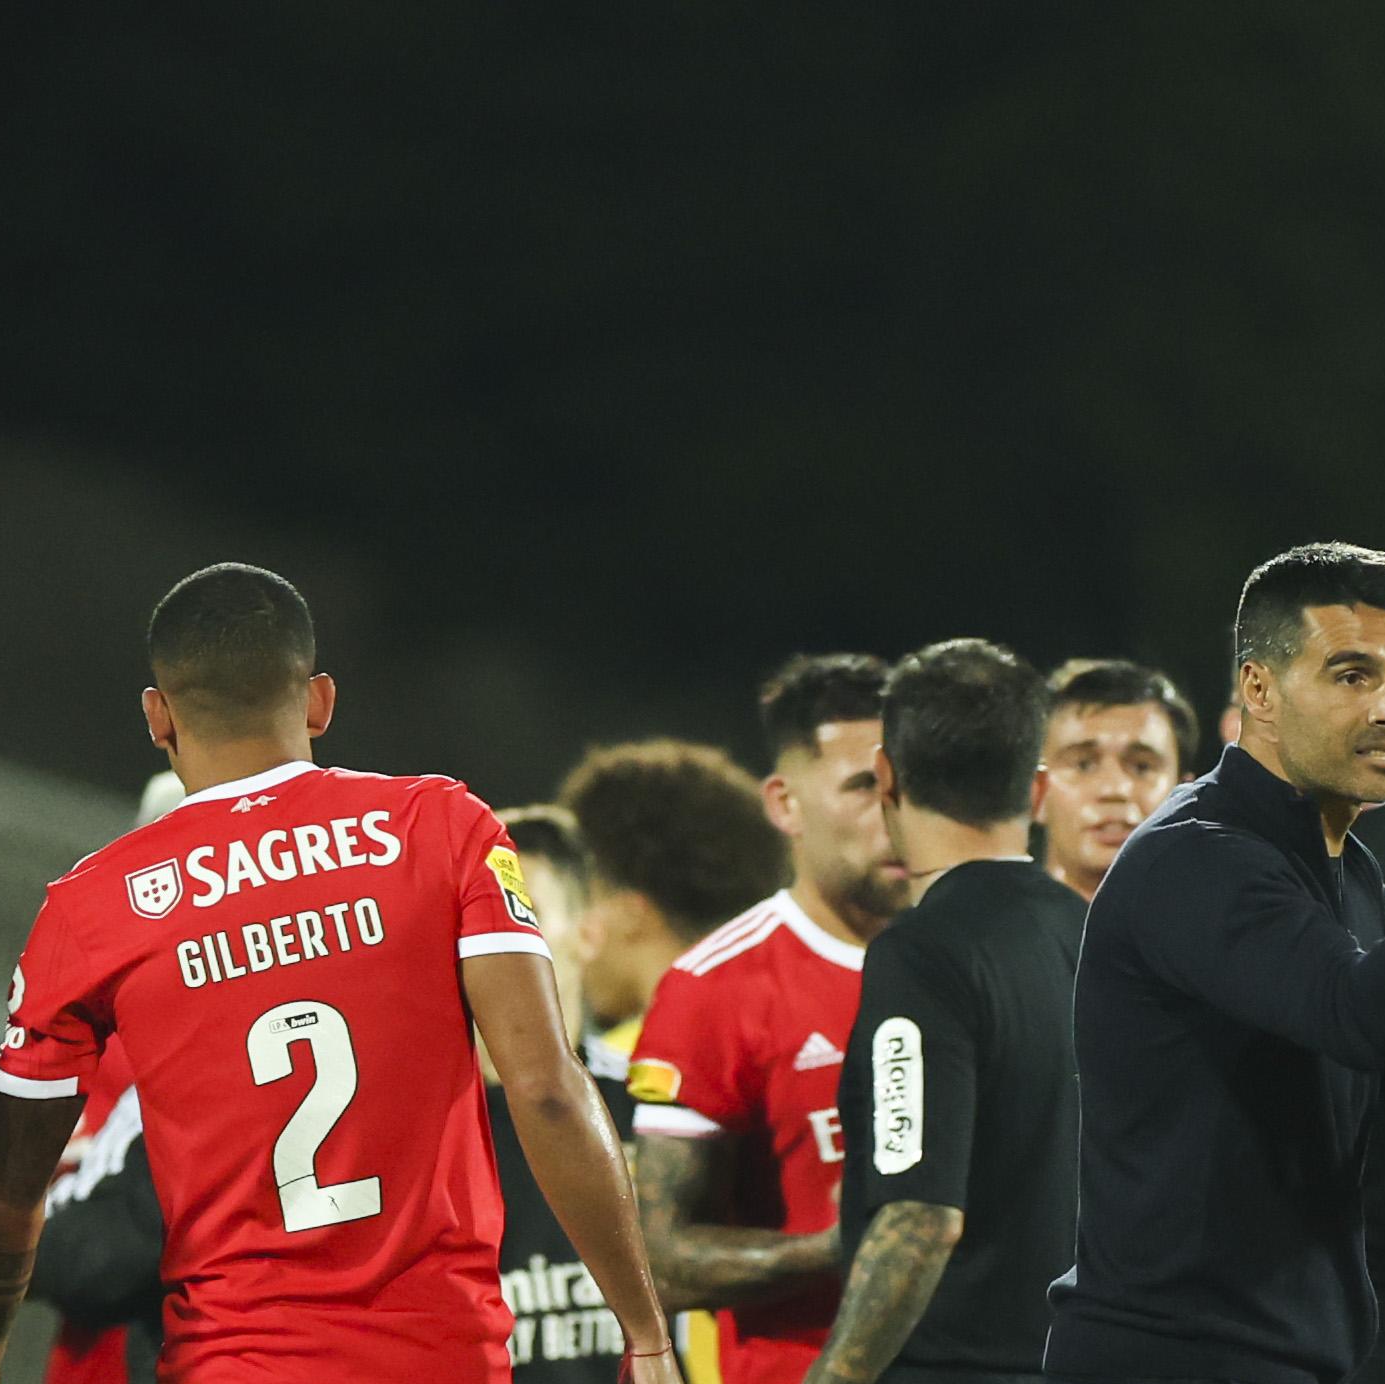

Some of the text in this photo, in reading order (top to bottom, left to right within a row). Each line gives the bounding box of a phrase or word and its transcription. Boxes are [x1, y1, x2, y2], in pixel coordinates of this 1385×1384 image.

[185, 810, 402, 907] SAGRES
[175, 897, 385, 989] GILBERTO
[291, 1014, 316, 1028] bwin
[246, 1000, 382, 1233] 2
